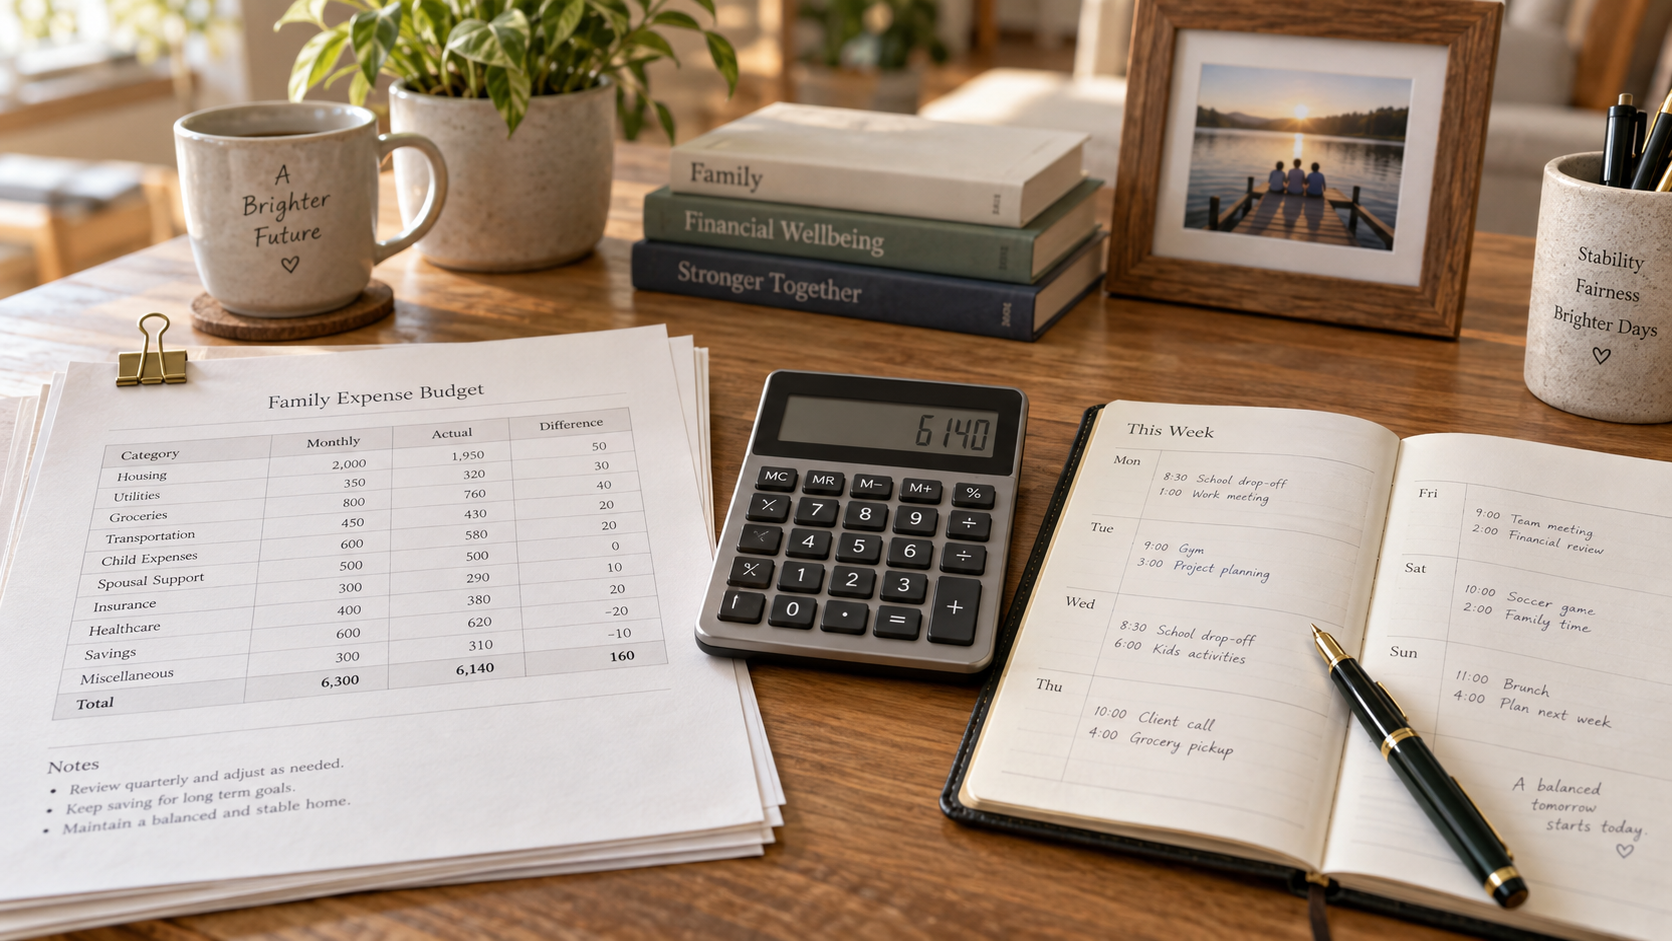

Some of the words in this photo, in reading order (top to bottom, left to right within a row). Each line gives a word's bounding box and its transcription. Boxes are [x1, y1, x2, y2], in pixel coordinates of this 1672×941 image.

[275, 164, 290, 185] A
[690, 162, 763, 193] Family
[242, 192, 330, 222] Brighter
[254, 226, 322, 247] Future
[685, 211, 774, 240] Financial
[781, 221, 885, 257] Wellbeing
[1578, 246, 1644, 274] Stability
[678, 261, 763, 292] Stronger
[769, 272, 862, 304] Together
[1576, 278, 1640, 302] Fairness
[1554, 305, 1613, 331] Brighter
[1617, 319, 1658, 340] Days
[268, 392, 331, 410] Family
[337, 390, 413, 407] Expense
[420, 384, 485, 399] Budget
[121, 449, 180, 461] Category
[306, 436, 360, 448] Monthly
[432, 428, 472, 439] Actual
[539, 418, 603, 431] Difference
[916, 414, 990, 451] 6140
[1127, 423, 1162, 436] This
[1169, 426, 1214, 439] Week
[117, 471, 167, 482] Housing
[332, 459, 366, 471] 2,000
[452, 450, 484, 462] 1,950
[592, 441, 607, 451] 50
[1114, 456, 1140, 466] Mon
[113, 491, 160, 502] Utilities
[343, 478, 366, 488] 350
[463, 469, 485, 479] 320
[595, 461, 609, 471] 30
[765, 471, 788, 481] MC
[812, 475, 835, 485] MR
[909, 483, 932, 493] M+
[1164, 472, 1188, 482] 8:30
[1196, 474, 1232, 486] School
[1238, 475, 1288, 490] drop-off
[109, 511, 168, 523] Groceries
[343, 497, 365, 508] 800
[464, 489, 486, 500] 760
[597, 480, 611, 490] 40
[1160, 488, 1182, 497] 1:00
[1192, 490, 1219, 500] Work
[1227, 492, 1269, 506] meeting
[1419, 489, 1438, 499] Fri
[106, 530, 195, 545] Transportation
[341, 518, 364, 528] 450
[464, 509, 487, 519] 430
[599, 500, 614, 510] 20
[811, 503, 823, 516] 7
[859, 507, 871, 521] 8
[910, 512, 922, 525] 9
[1091, 522, 1114, 534] Tue
[1476, 508, 1500, 520] 9:00
[1511, 514, 1540, 528] Team
[1547, 523, 1593, 541] meeting
[101, 554, 136, 567] Child
[141, 551, 198, 565] Expenses
[340, 538, 364, 549] 600
[465, 529, 488, 540] 580
[602, 520, 617, 531] 20
[802, 534, 814, 548] 4
[853, 539, 865, 553] 5
[904, 544, 916, 557] 6
[1144, 541, 1168, 552] 9:00
[1179, 544, 1204, 558] Gym
[1472, 524, 1498, 536] 2:00
[1509, 530, 1561, 548] Financial
[1567, 540, 1604, 555] review
[97, 576, 147, 591] Spousal
[153, 572, 205, 587] Support
[339, 560, 363, 571] 500
[466, 551, 489, 561] 500
[611, 541, 619, 551] 0
[798, 568, 805, 582] 1
[1137, 558, 1163, 568] 3:00
[1174, 560, 1215, 576] Project
[1220, 564, 1270, 584] planning
[1405, 563, 1426, 574] Sat
[93, 599, 156, 612] Insurance
[338, 582, 362, 594] 300
[466, 572, 490, 583] 290
[607, 562, 622, 572] 10
[846, 573, 858, 587] 2
[898, 578, 910, 592] 3
[89, 621, 161, 636] Healthcare
[337, 605, 361, 616] 400
[467, 594, 491, 605] 380
[609, 584, 625, 594] 20
[786, 602, 799, 616] 0
[1066, 596, 1095, 610] Wed
[1465, 585, 1496, 597] 10:00
[1507, 591, 1553, 608] Soccer
[1561, 604, 1596, 617] game
[1464, 602, 1492, 614] 2:00
[1505, 609, 1550, 631] Family
[1559, 620, 1591, 633] time
[84, 646, 136, 662] Savings
[336, 628, 361, 639] 600
[467, 616, 492, 628] 620
[1120, 620, 1147, 632] 8:30
[1156, 625, 1195, 640] School
[1201, 630, 1256, 648] drop-off
[80, 668, 174, 686] Miscellaneous
[335, 651, 360, 663] 300
[468, 639, 493, 651] 310
[1114, 638, 1142, 650] 6:00
[1152, 643, 1180, 656] Kids
[1188, 648, 1246, 664] activities
[1390, 646, 1418, 659] Sun
[76, 696, 114, 710] Total
[321, 674, 359, 689] 6,300
[456, 662, 494, 676] 6,140
[610, 650, 635, 661] 160
[1036, 678, 1062, 692] Thu
[1456, 670, 1489, 684] 11:00
[1503, 678, 1550, 697] Brunch
[1094, 706, 1127, 719] 10:00
[1138, 712, 1180, 727] Client
[1187, 718, 1215, 732] call
[1453, 690, 1485, 704] 4:00
[1500, 697, 1529, 714] Plan
[1538, 708, 1568, 721] next
[1577, 715, 1612, 728] week
[1089, 727, 1118, 740] 4:00
[1130, 732, 1181, 754] Grocery
[1187, 741, 1234, 760] pickup
[47, 760, 100, 775] Notes
[69, 780, 121, 795] Review
[125, 775, 189, 792] quarterly
[193, 771, 219, 784] and
[223, 767, 265, 782] adjust
[270, 766, 285, 776] as
[289, 758, 344, 773] needed.
[1512, 777, 1525, 791] A
[1537, 778, 1602, 795] balanced
[66, 801, 103, 816] Keep
[107, 796, 152, 811] saving
[158, 793, 179, 807] for
[183, 790, 214, 804] long
[218, 788, 251, 800] term
[255, 783, 296, 799] goals.
[1531, 799, 1597, 813] tomorrow
[62, 819, 132, 835] Maintain
[138, 817, 146, 827] a
[152, 809, 217, 826] balanced
[223, 805, 250, 819] and
[256, 801, 300, 815] stable
[306, 797, 351, 810] home.
[1546, 819, 1591, 832] starts
[1601, 820, 1648, 842] today.
